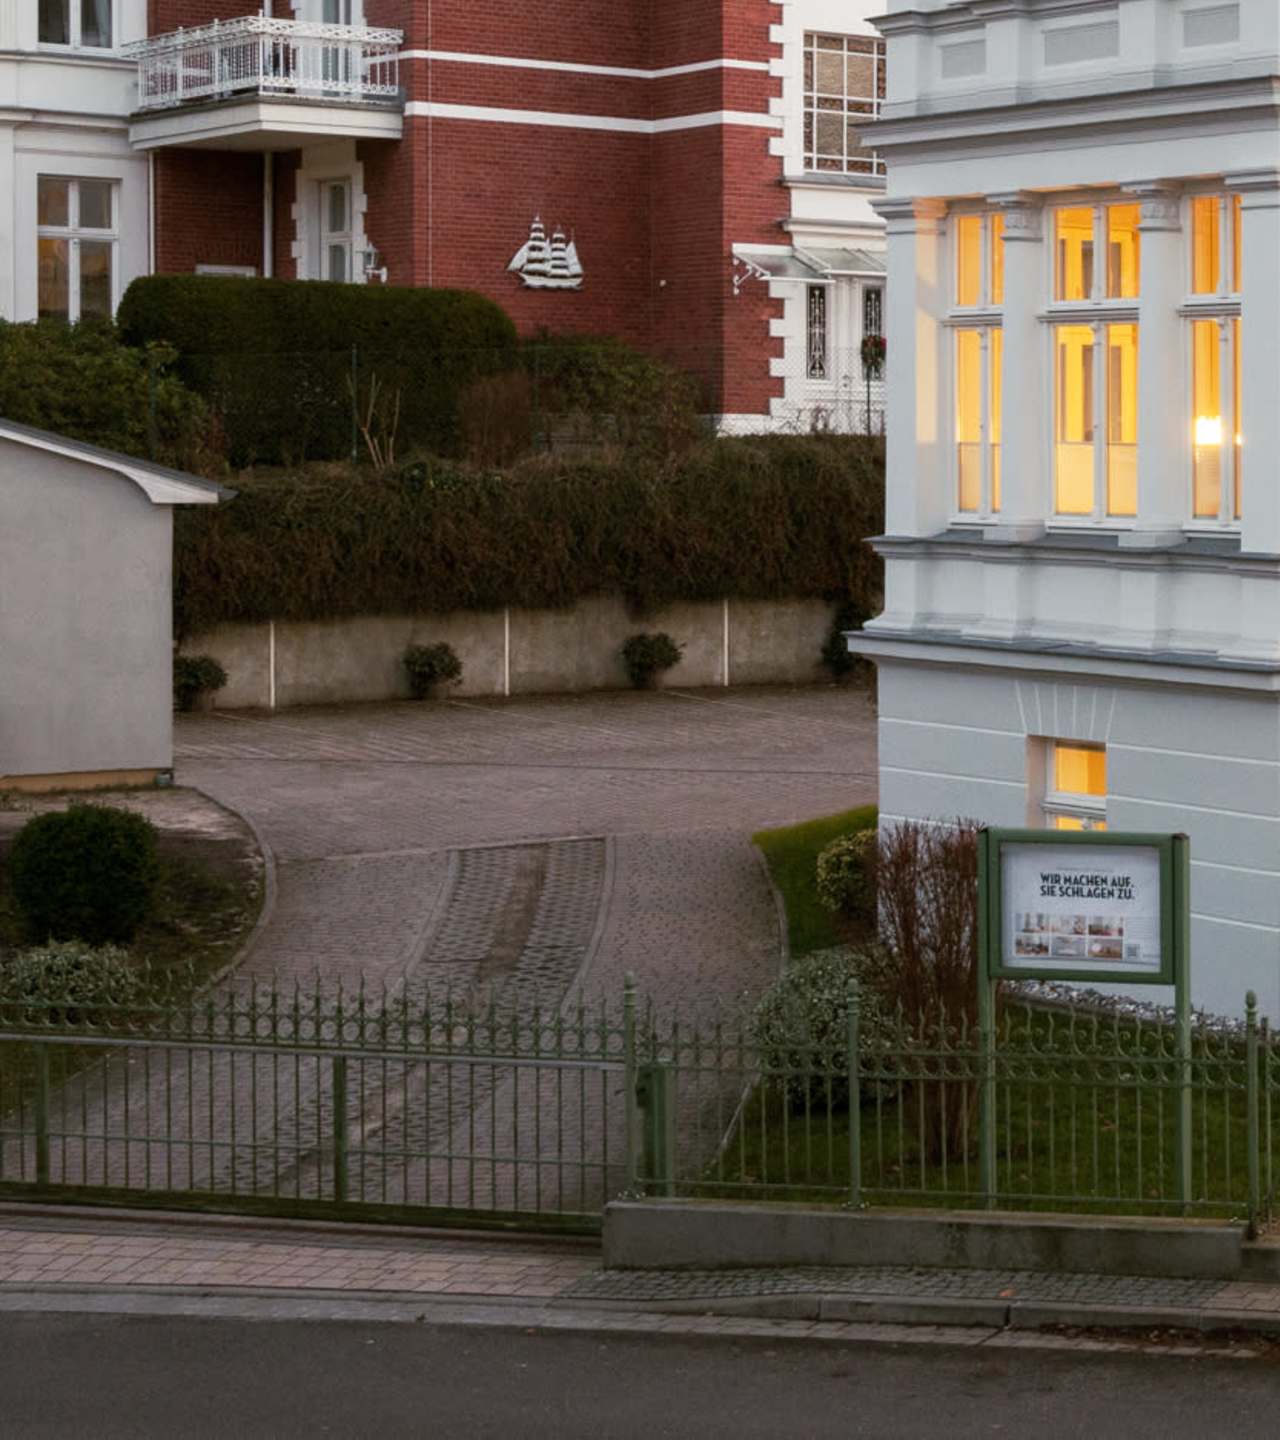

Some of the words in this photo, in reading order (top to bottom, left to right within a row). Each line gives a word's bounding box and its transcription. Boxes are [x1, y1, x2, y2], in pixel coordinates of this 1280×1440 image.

[1040, 873, 1061, 885] WIR
[1064, 875, 1108, 886] MACHEN
[1111, 876, 1134, 888] AUF.
[1040, 885, 1056, 897] SIE
[1059, 886, 1115, 899] SCHLAGEN
[1118, 888, 1135, 900] ZU.
